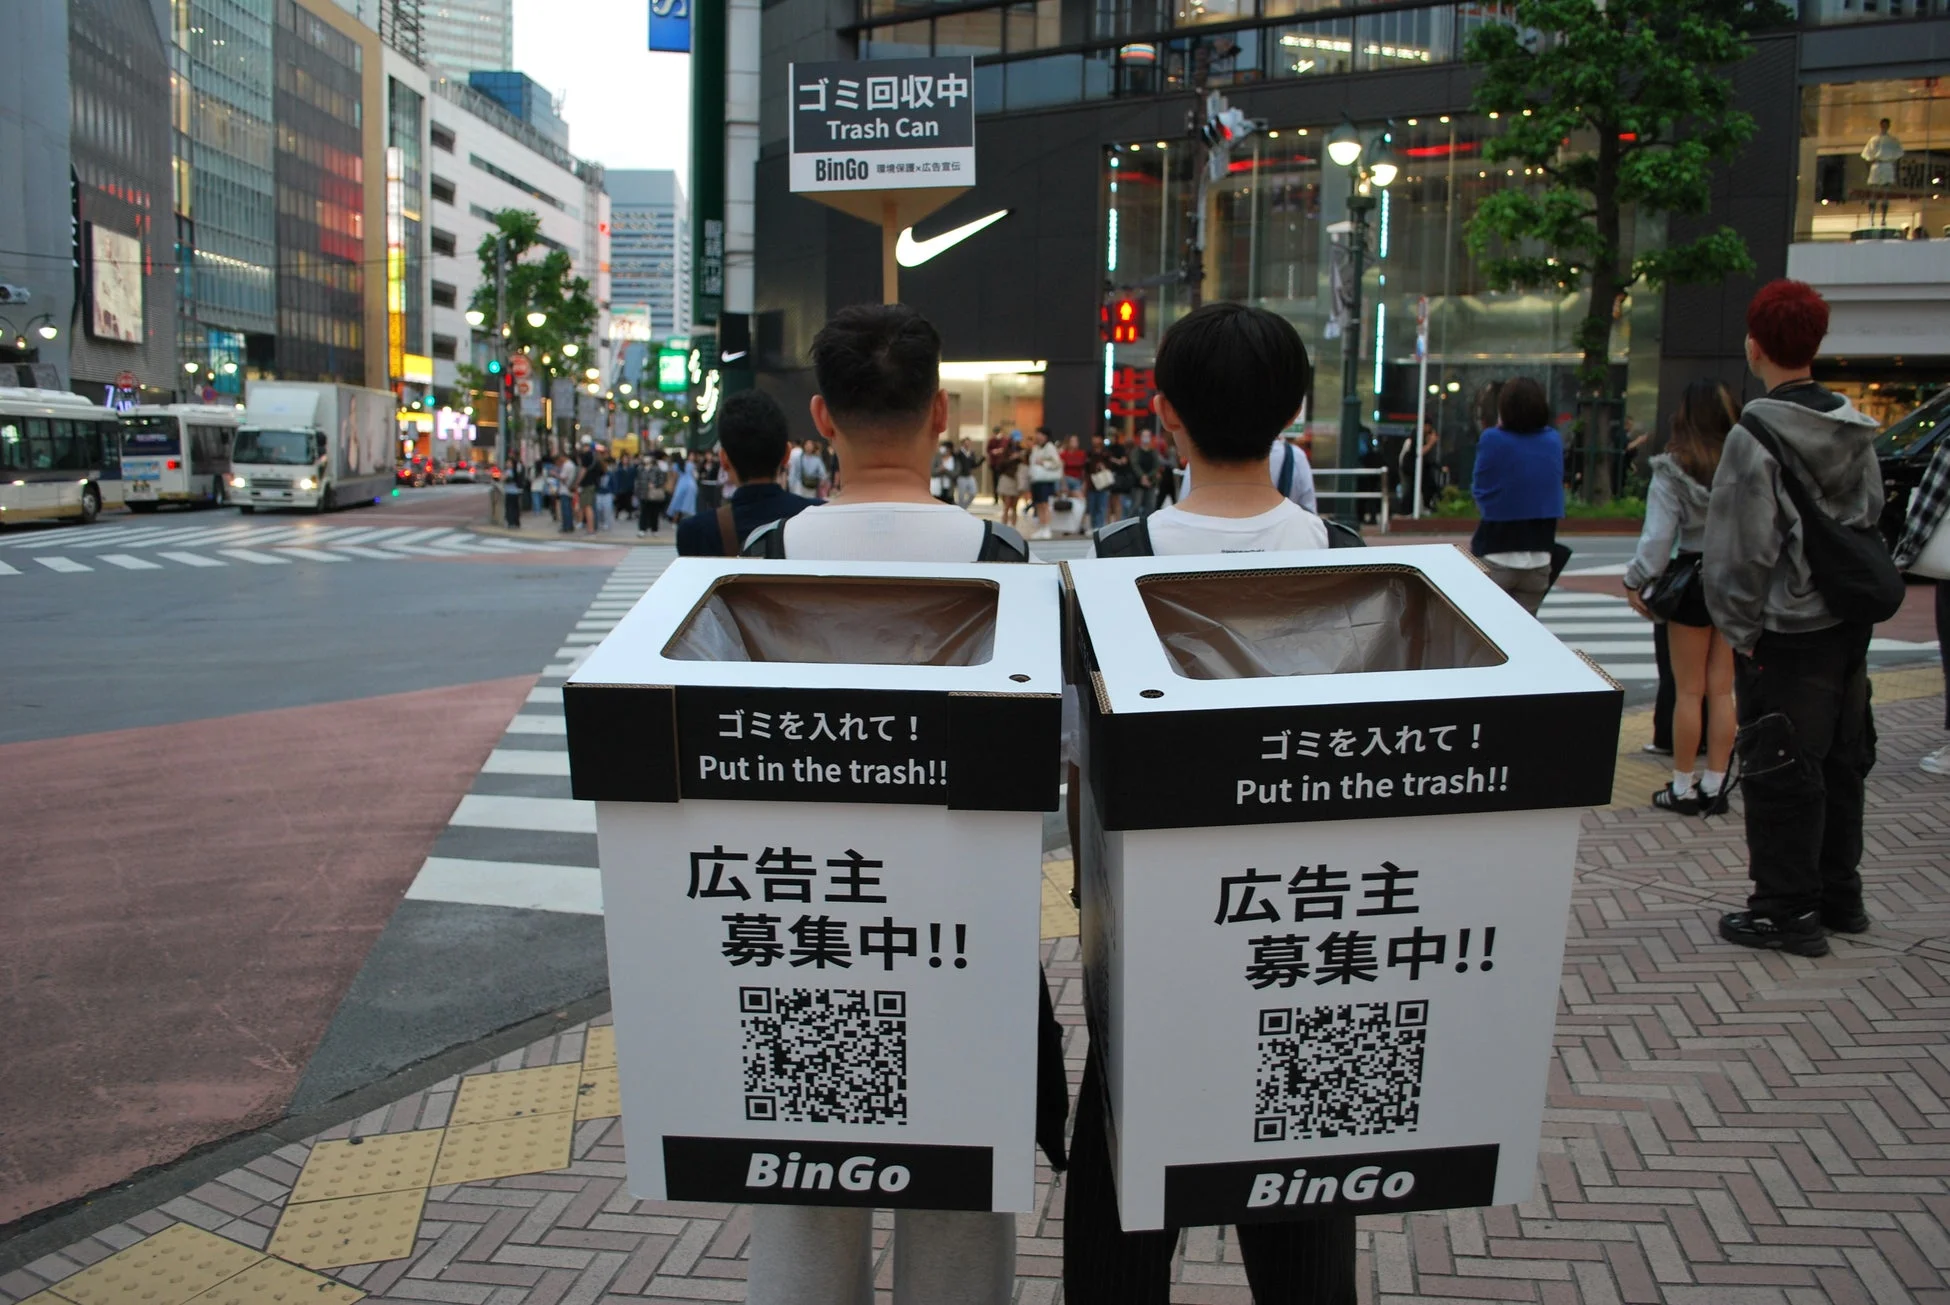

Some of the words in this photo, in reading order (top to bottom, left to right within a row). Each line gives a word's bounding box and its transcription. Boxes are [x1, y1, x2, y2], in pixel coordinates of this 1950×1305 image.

[799, 72, 968, 112] ゴミ回収中
[826, 118, 890, 140] Trash
[895, 118, 939, 138] Can
[815, 157, 869, 182] BinGo
[718, 708, 918, 742] ゴミを入れて！
[1261, 723, 1481, 760] ゴミを入れて！
[699, 755, 751, 781] Put
[757, 754, 785, 782] in
[791, 755, 842, 783] the
[848, 758, 947, 786] trash!!
[1236, 778, 1293, 805] Put
[1301, 774, 1331, 802] in
[1339, 772, 1394, 800] the
[1402, 766, 1508, 797] trash!!
[686, 844, 887, 904] 広告主
[1213, 860, 1420, 926] 広告主
[721, 912, 968, 971] 募集中!!
[1244, 925, 1497, 991] 募集中!!
[745, 1151, 911, 1193] BinGo
[1246, 1165, 1415, 1208] BinGo
